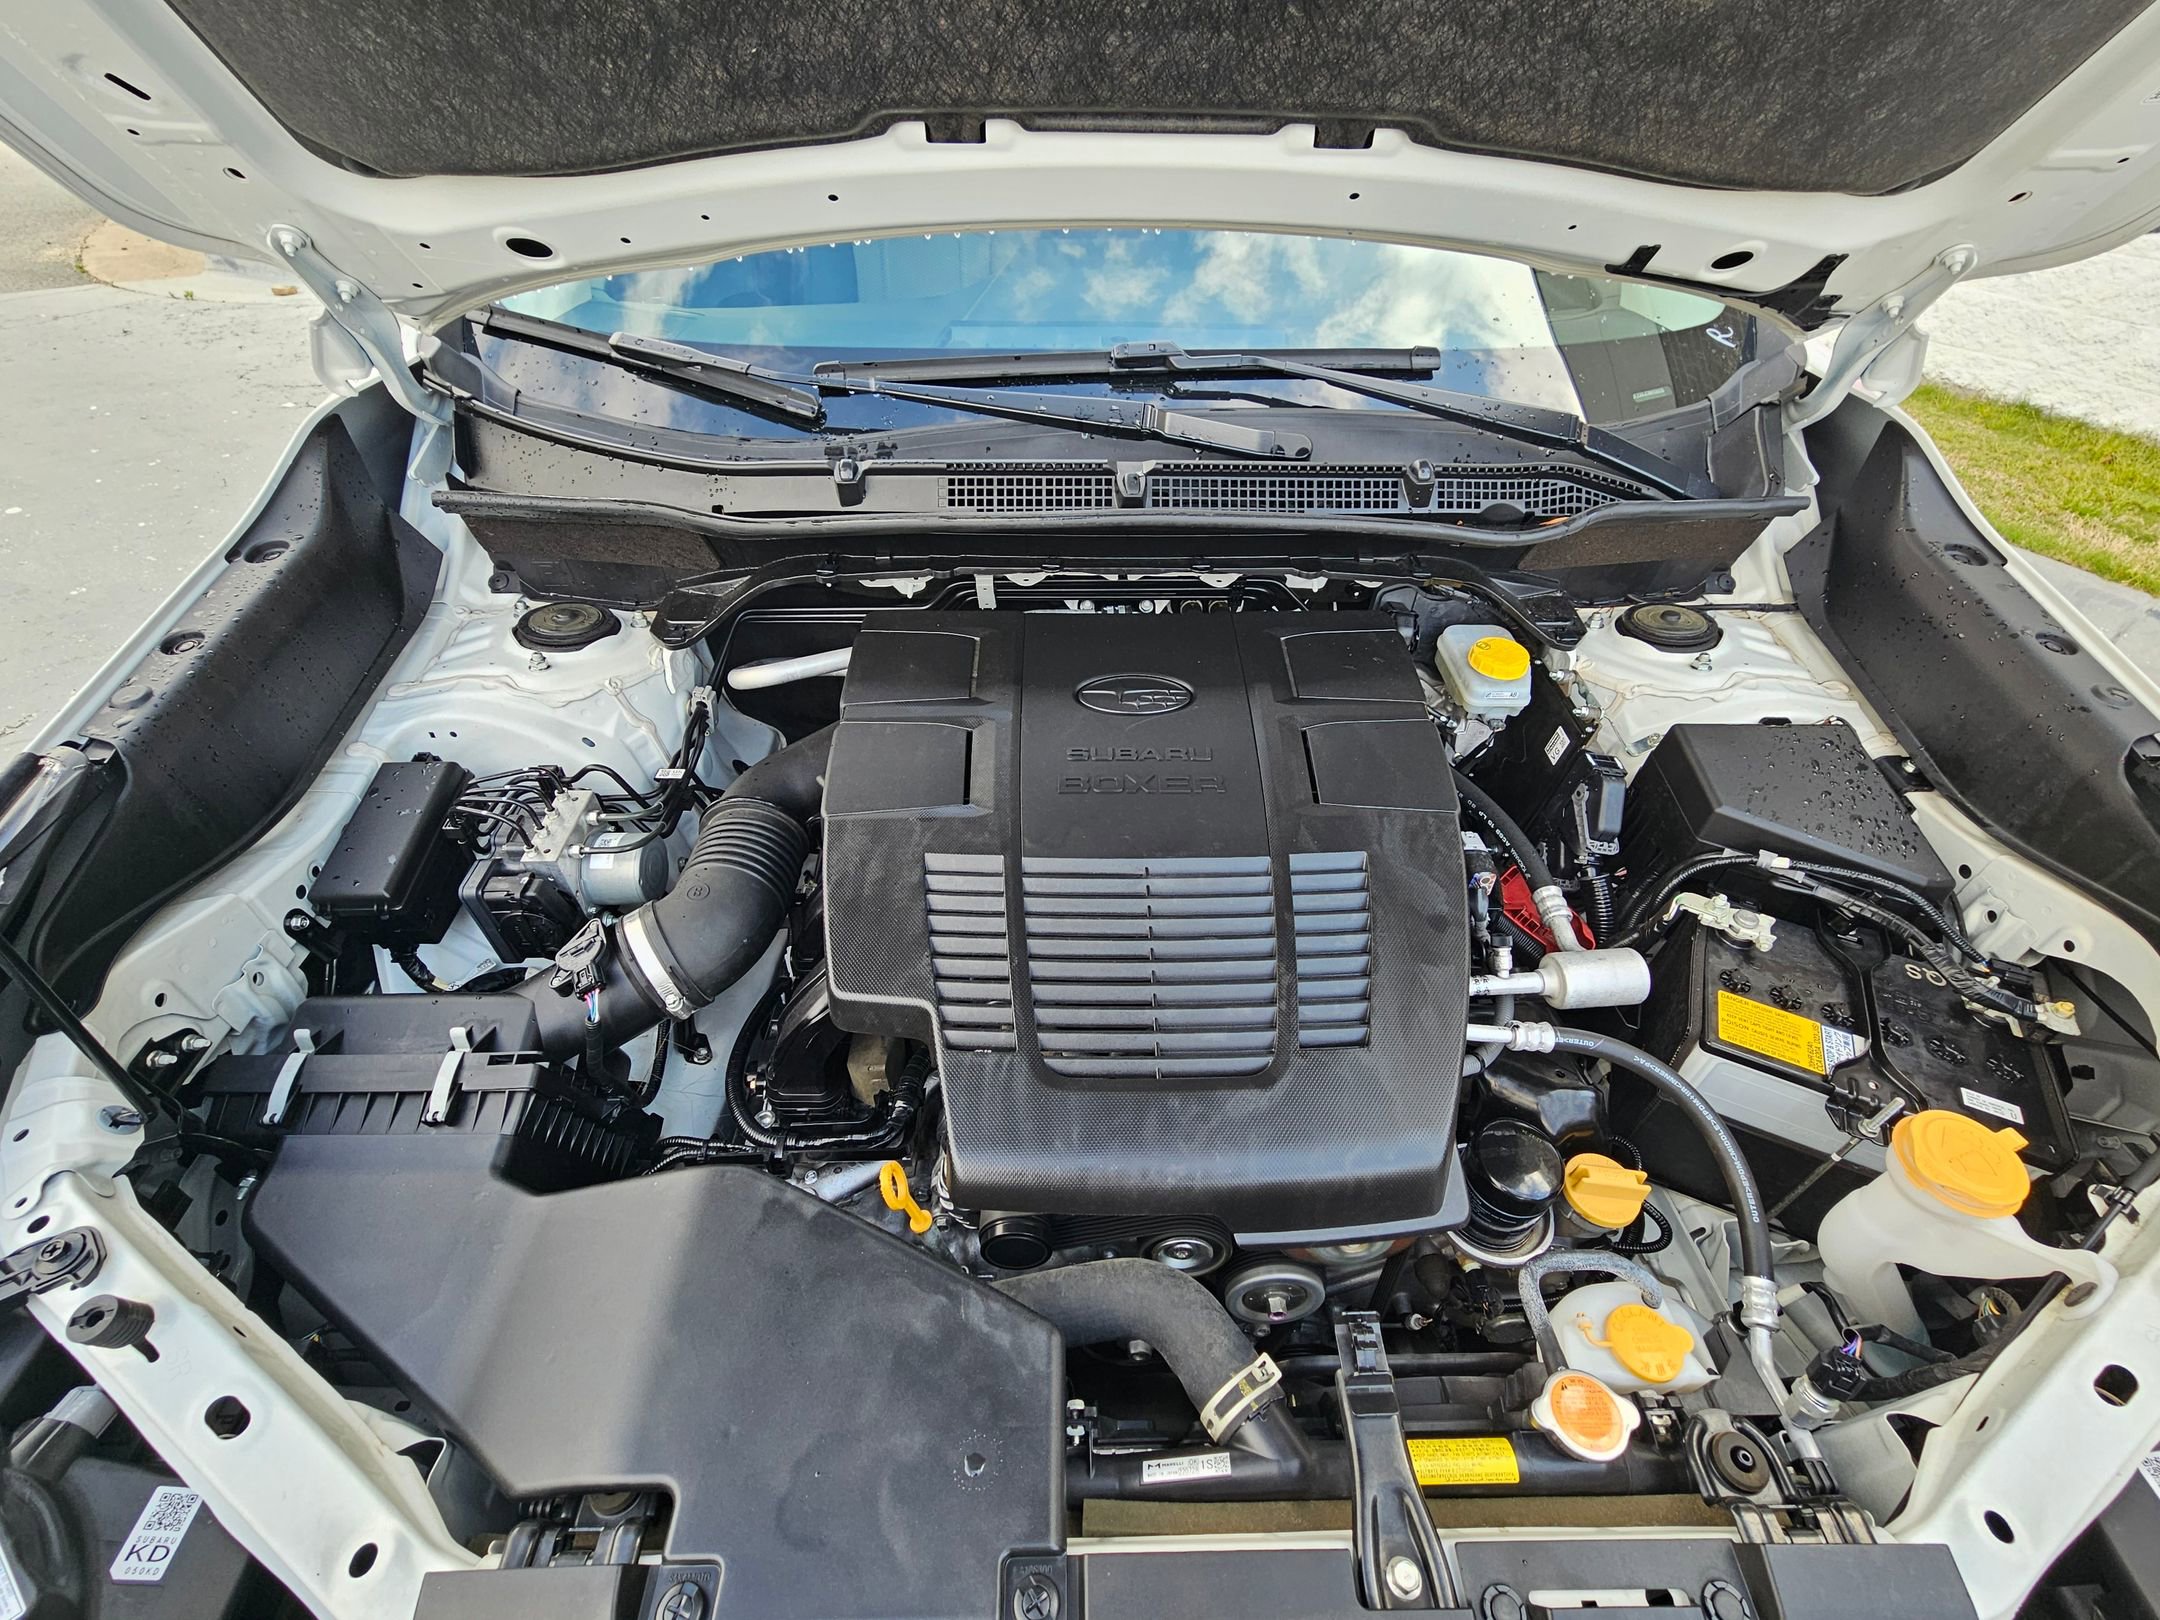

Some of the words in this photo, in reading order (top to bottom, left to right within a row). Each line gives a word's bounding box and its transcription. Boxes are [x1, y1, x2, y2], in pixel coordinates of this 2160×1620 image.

[1066, 747, 1213, 762] SUBARU
[1057, 773, 1227, 794] BOXER
[1720, 992, 1749, 1006] DANGER
[1721, 1017, 1749, 1031] POISON
[135, 1536, 178, 1545] SUBARU
[124, 1544, 170, 1562] KD
